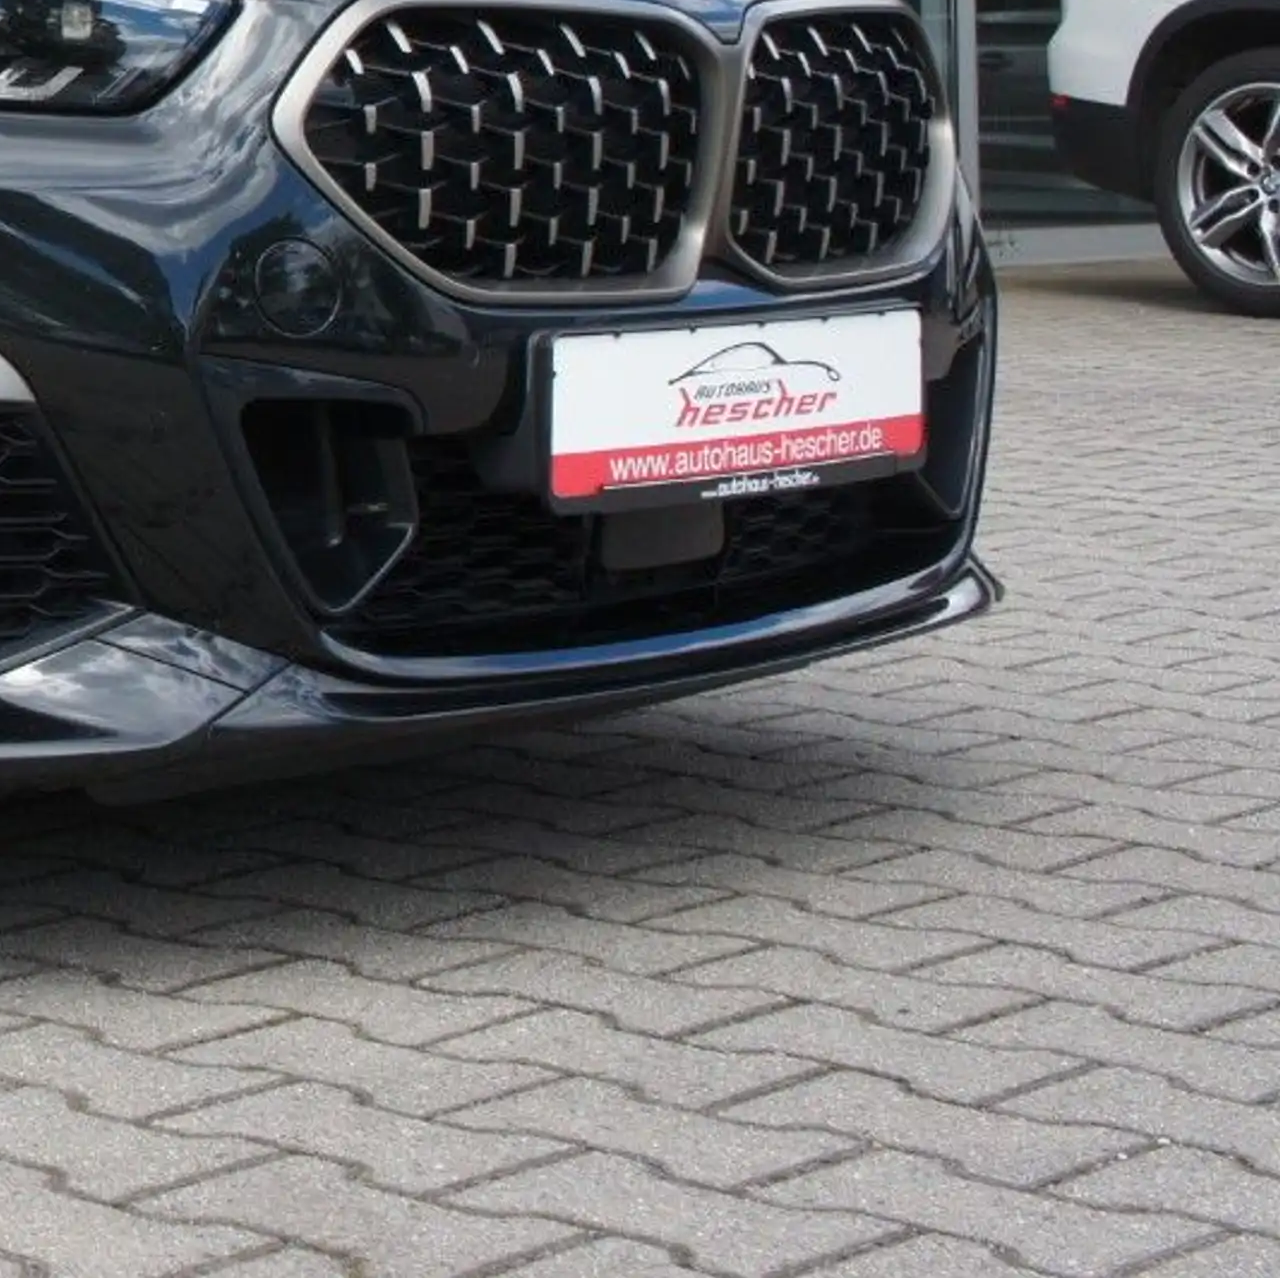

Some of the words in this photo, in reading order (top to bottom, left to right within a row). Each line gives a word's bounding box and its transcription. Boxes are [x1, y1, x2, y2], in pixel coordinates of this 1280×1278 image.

[674, 377, 838, 428] hescher
[693, 379, 772, 401] AUTOHAUS
[609, 424, 883, 481] www.autohaus-hescher.de
[701, 471, 820, 499] autohaus-hescher.
